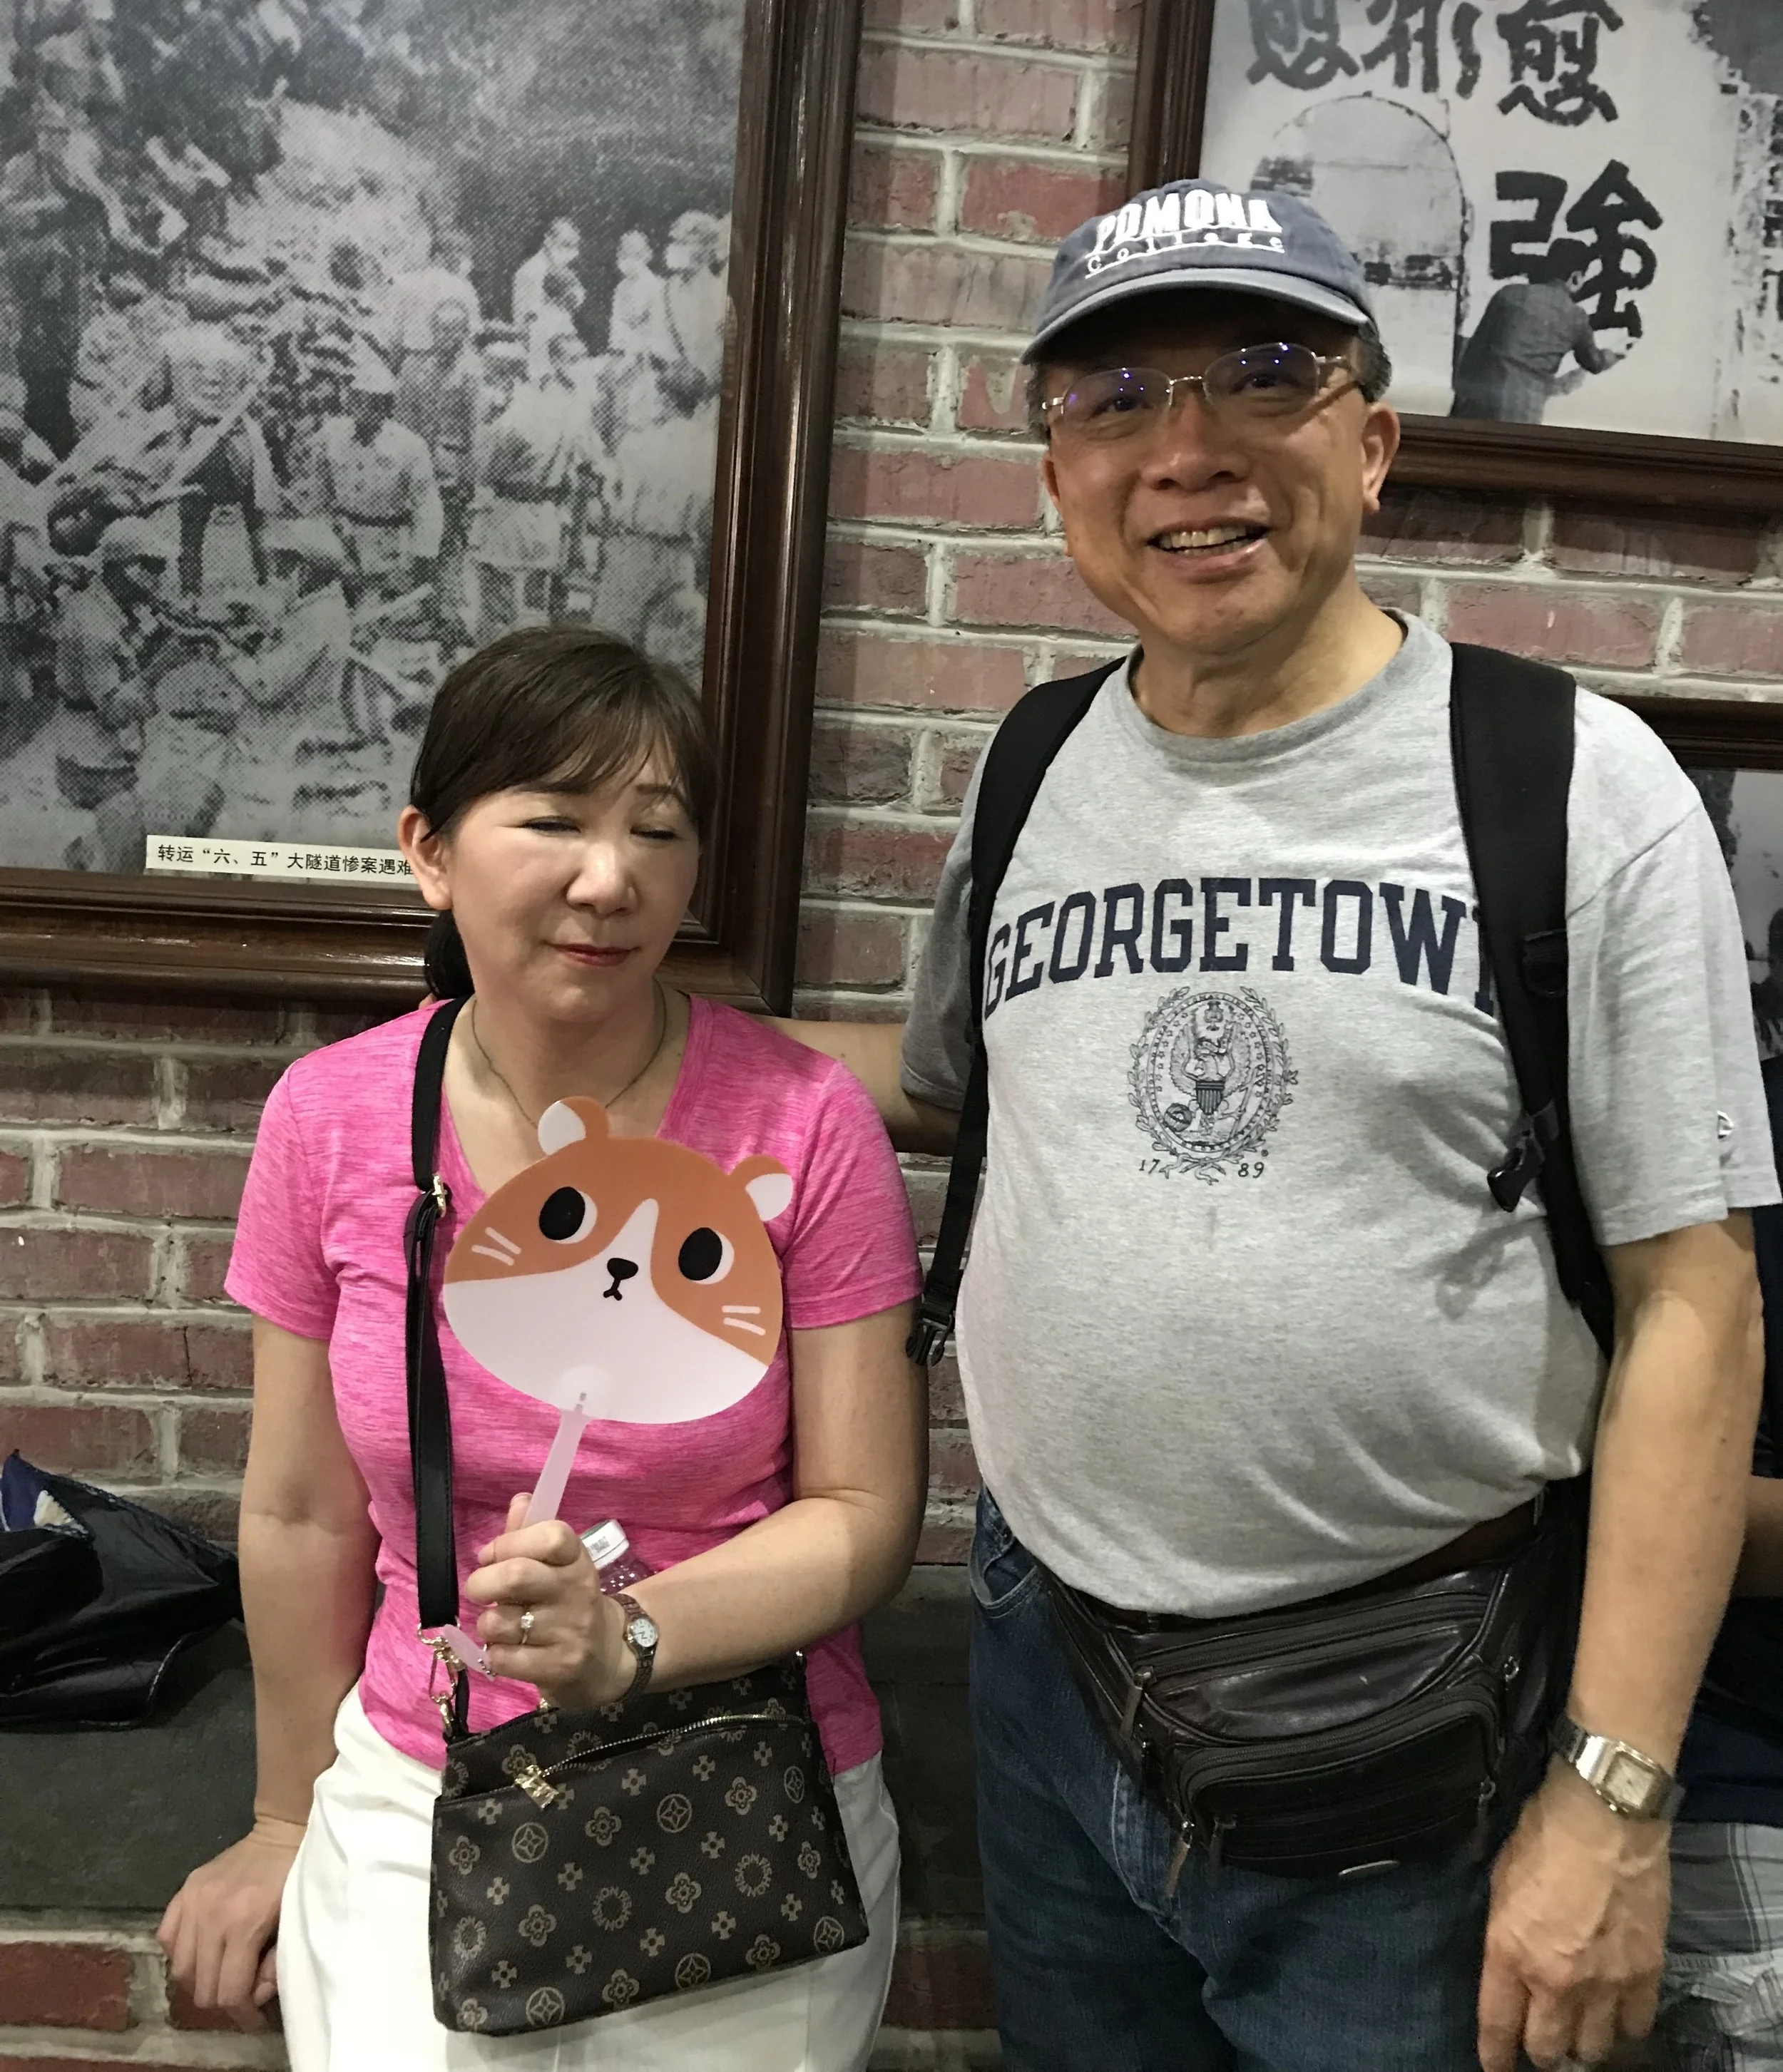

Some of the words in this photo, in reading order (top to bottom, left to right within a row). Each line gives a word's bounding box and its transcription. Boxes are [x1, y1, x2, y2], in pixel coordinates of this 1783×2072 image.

[1088, 189, 1282, 254] POMONA
[1139, 1159, 1160, 1174] 17
[1237, 1161, 1265, 1179] 89
